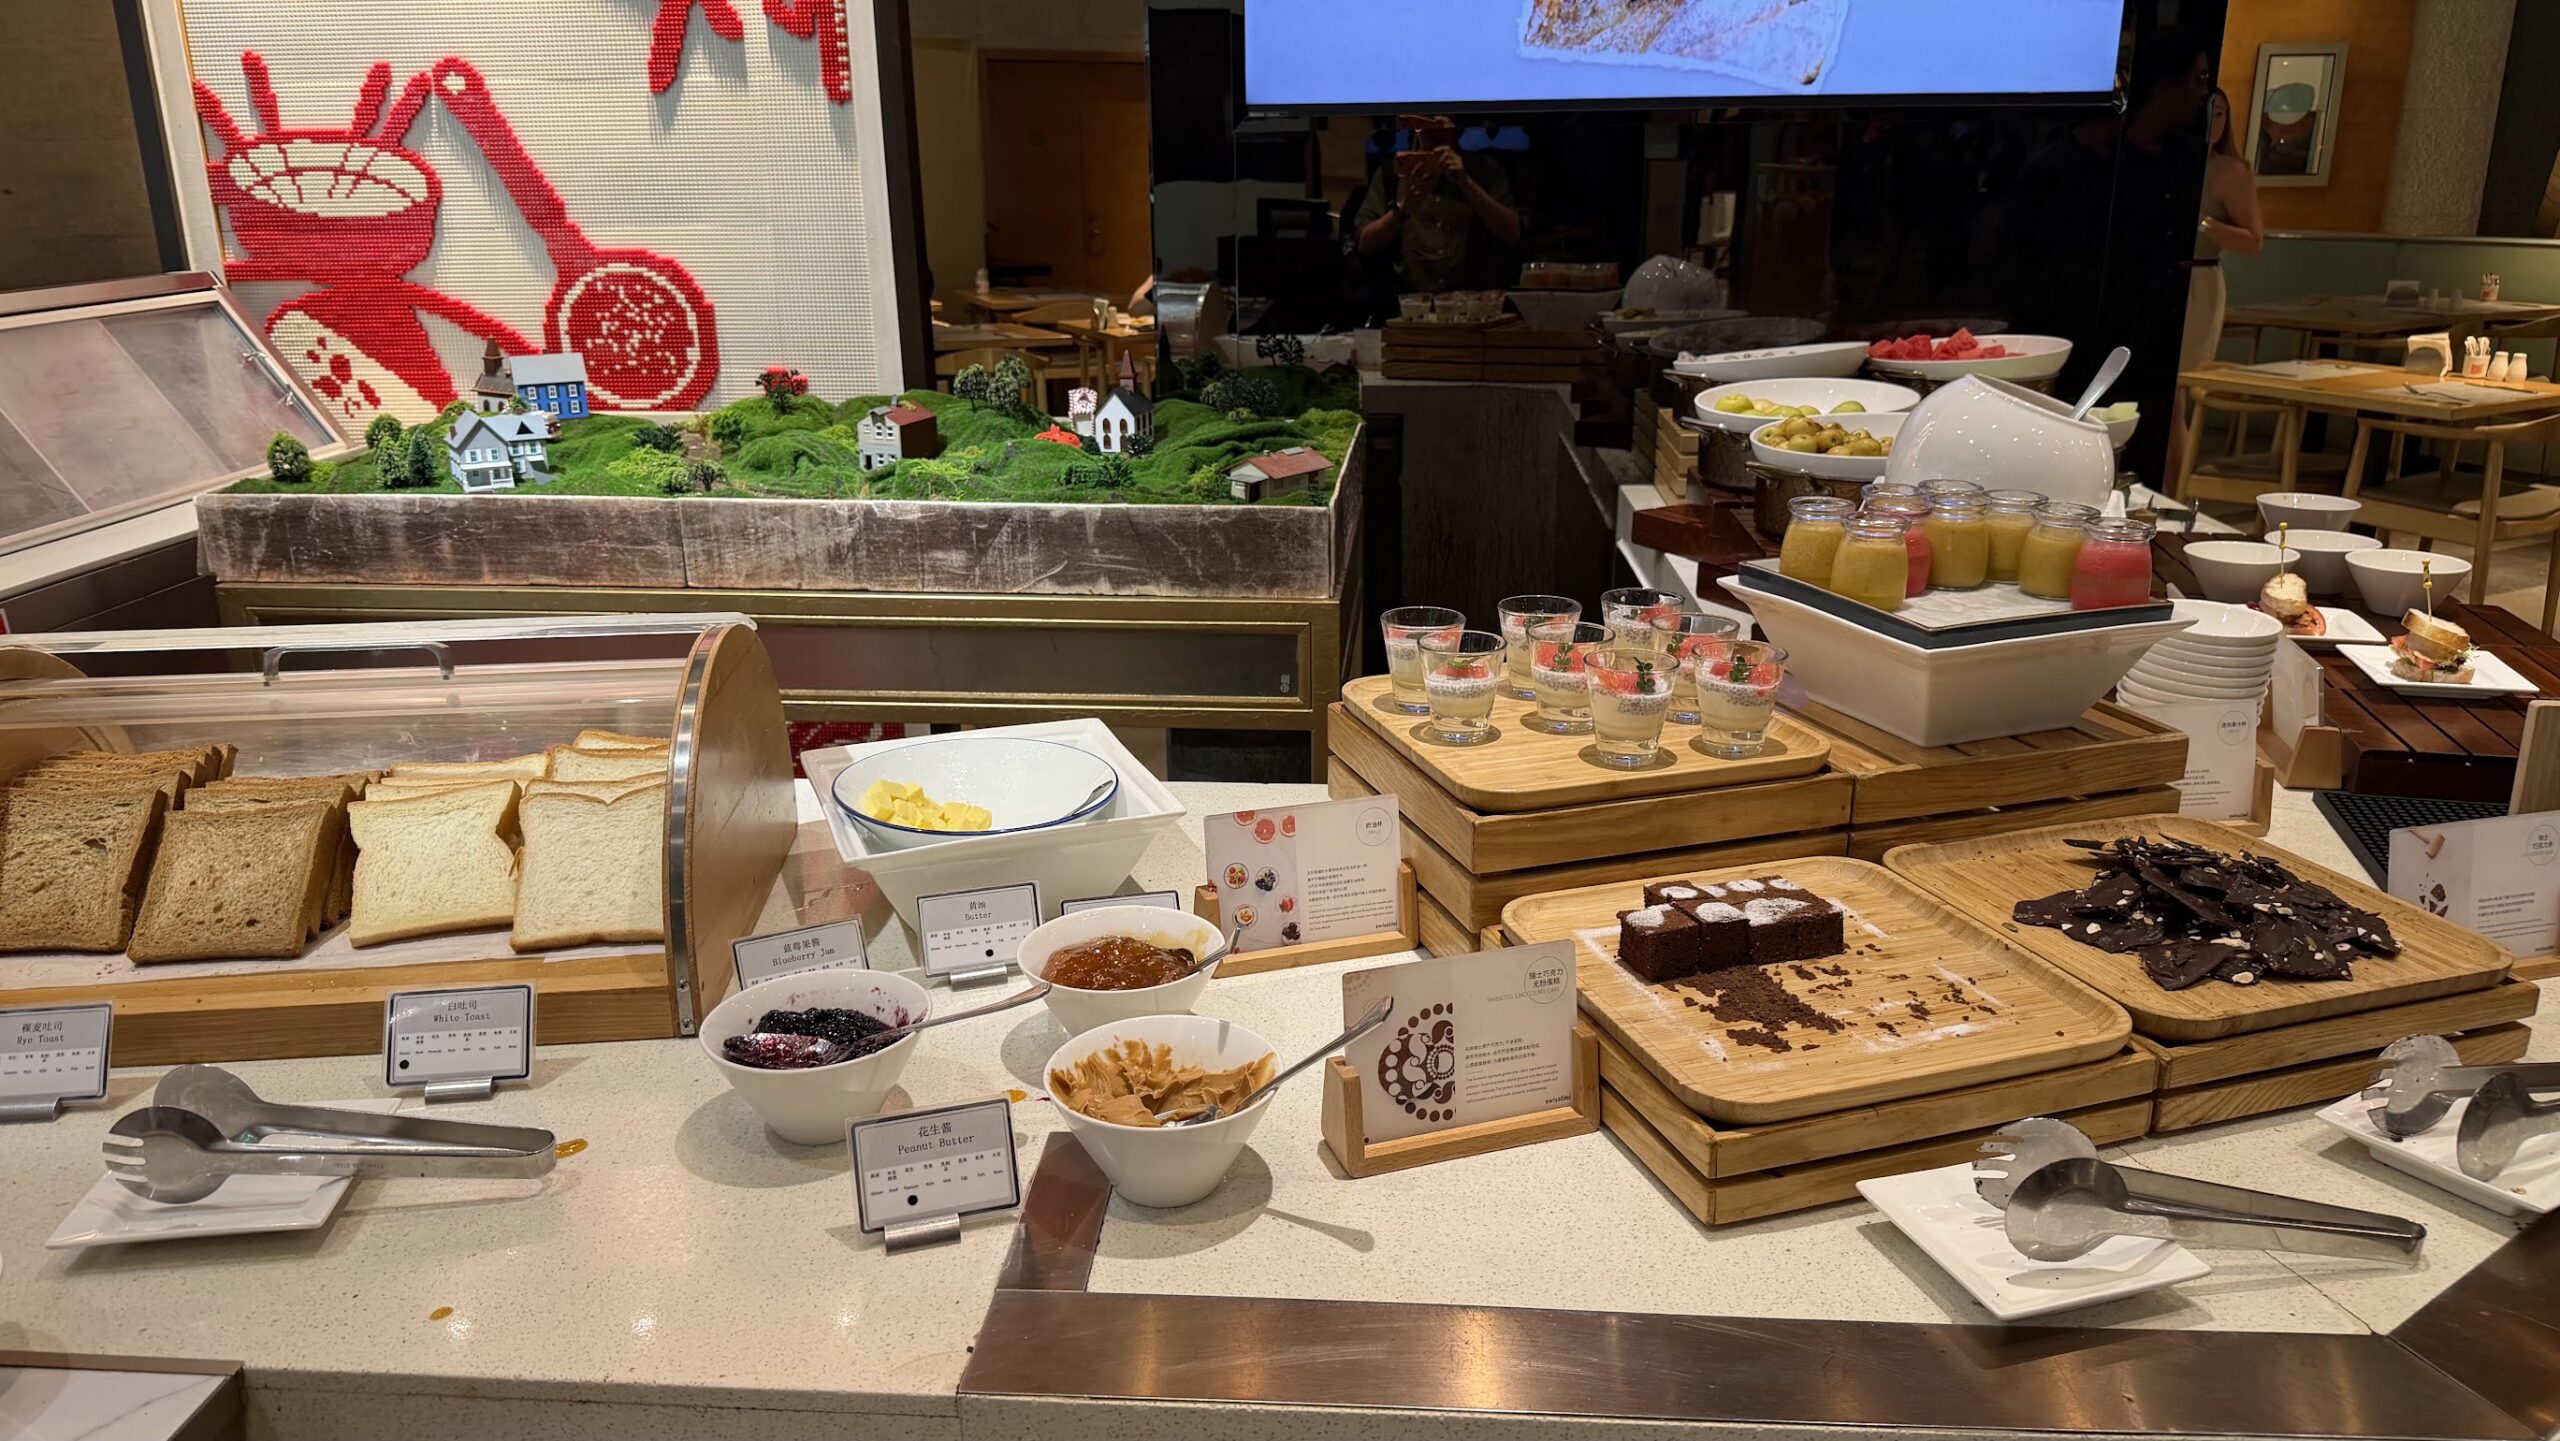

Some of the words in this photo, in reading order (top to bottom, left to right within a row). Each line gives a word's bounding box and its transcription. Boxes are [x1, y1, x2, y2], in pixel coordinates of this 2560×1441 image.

[964, 911, 992, 921] Butter
[772, 951, 816, 967] Blueberry
[820, 947, 836, 958] Jam
[447, 1000, 478, 1011] 白吐司
[433, 1014, 459, 1023] White
[465, 1012, 490, 1021] Toast
[17, 1036, 33, 1046] Rye
[38, 1034, 64, 1044] Toast
[917, 1122, 952, 1138] 花生酱
[898, 1140, 934, 1155] Peanut
[939, 1134, 975, 1148] Butter
